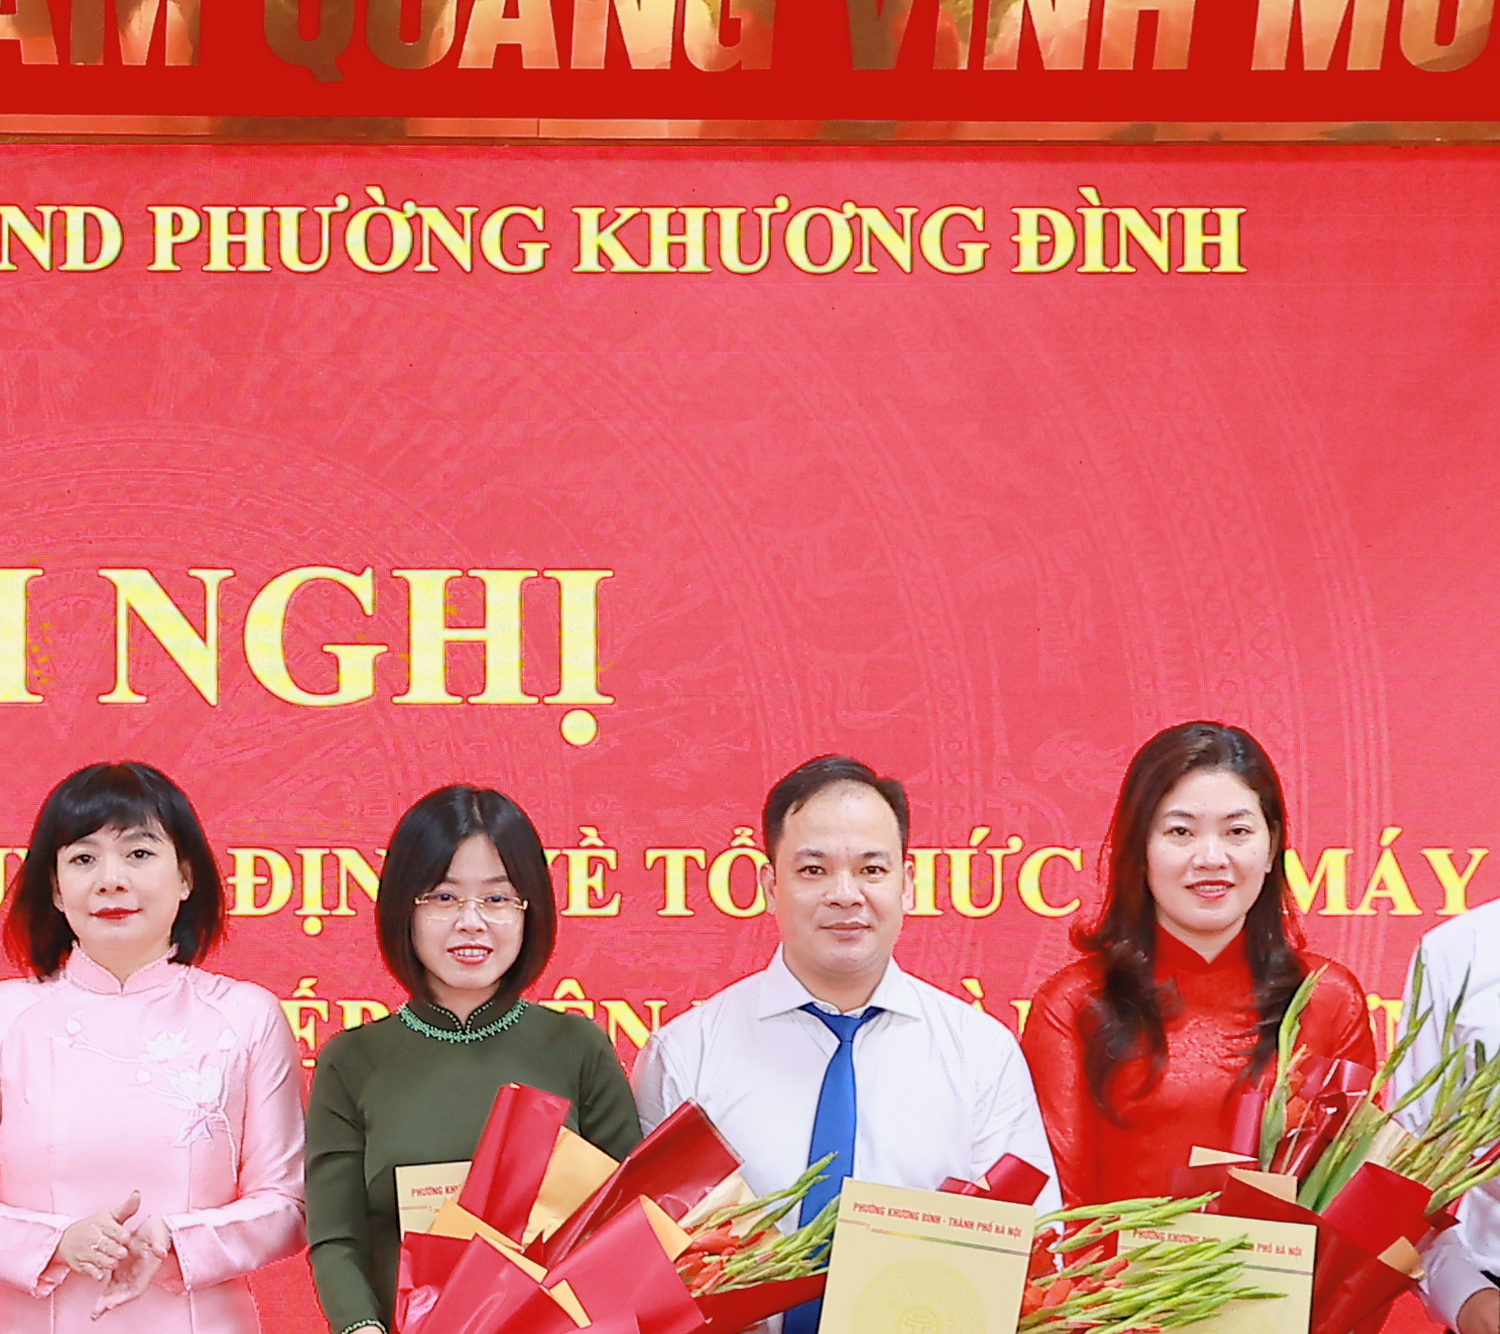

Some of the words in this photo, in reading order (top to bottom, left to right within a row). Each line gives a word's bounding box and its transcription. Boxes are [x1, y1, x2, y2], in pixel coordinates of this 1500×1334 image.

[146, 184, 550, 275] PHƯỜNG
[570, 196, 990, 275] KHƯƠNG
[1010, 185, 1249, 274] ĐÌNH
[95, 564, 617, 746] NGHỊ
[645, 827, 771, 918] TỔ
[1283, 826, 1491, 916] MÁY
